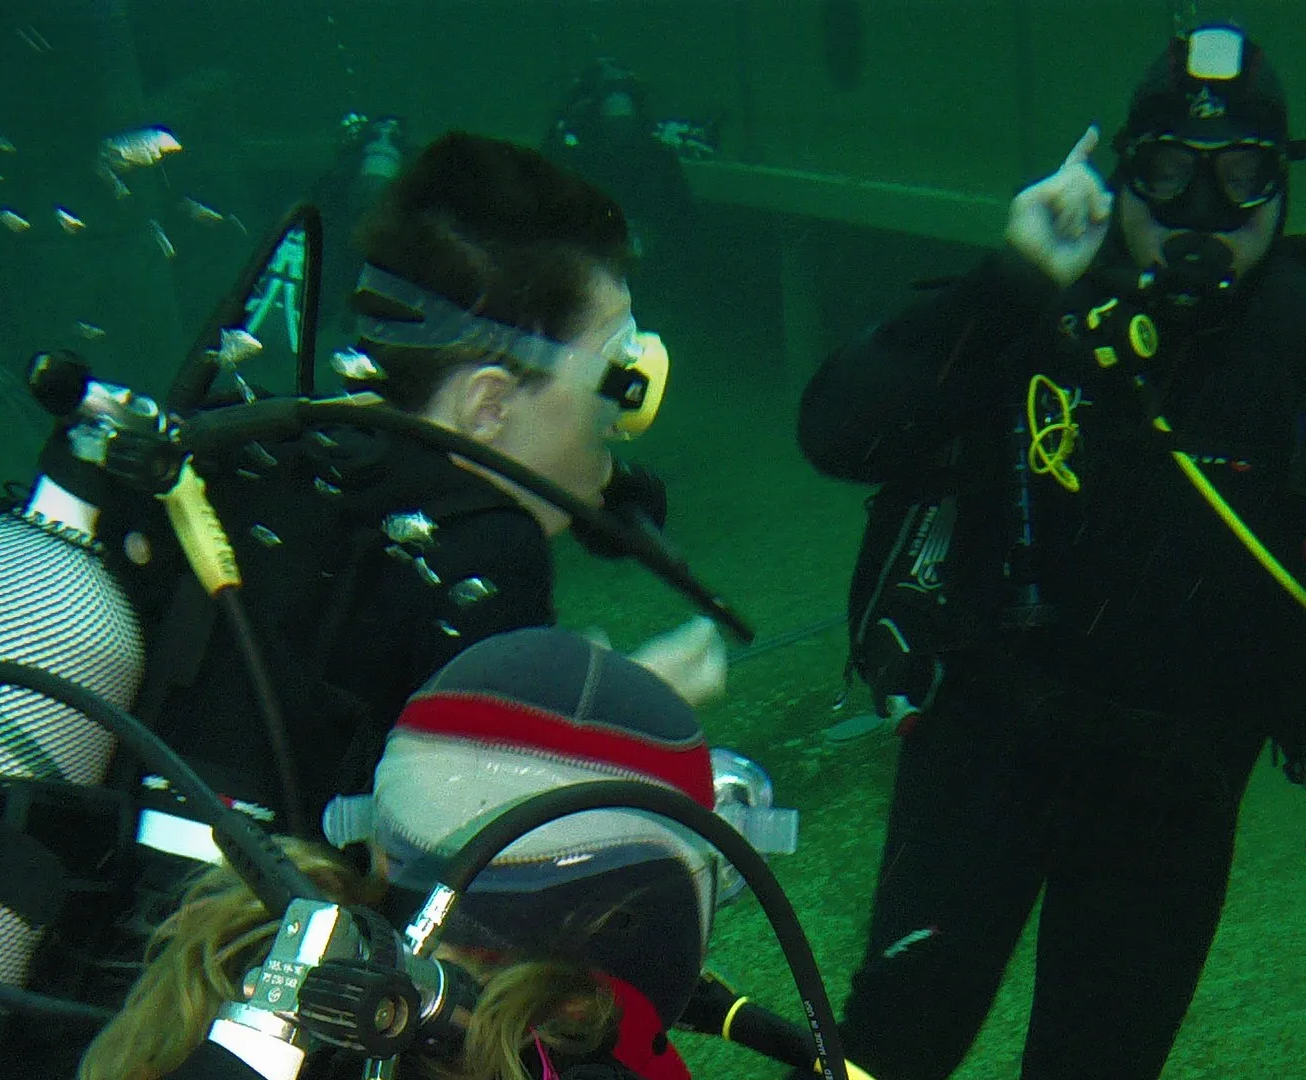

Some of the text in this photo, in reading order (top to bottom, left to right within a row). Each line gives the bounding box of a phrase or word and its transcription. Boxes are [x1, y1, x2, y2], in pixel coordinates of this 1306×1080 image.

[803, 999, 815, 1018] USA
[810, 1020, 820, 1030] IN
[814, 1031, 827, 1057] MADE
